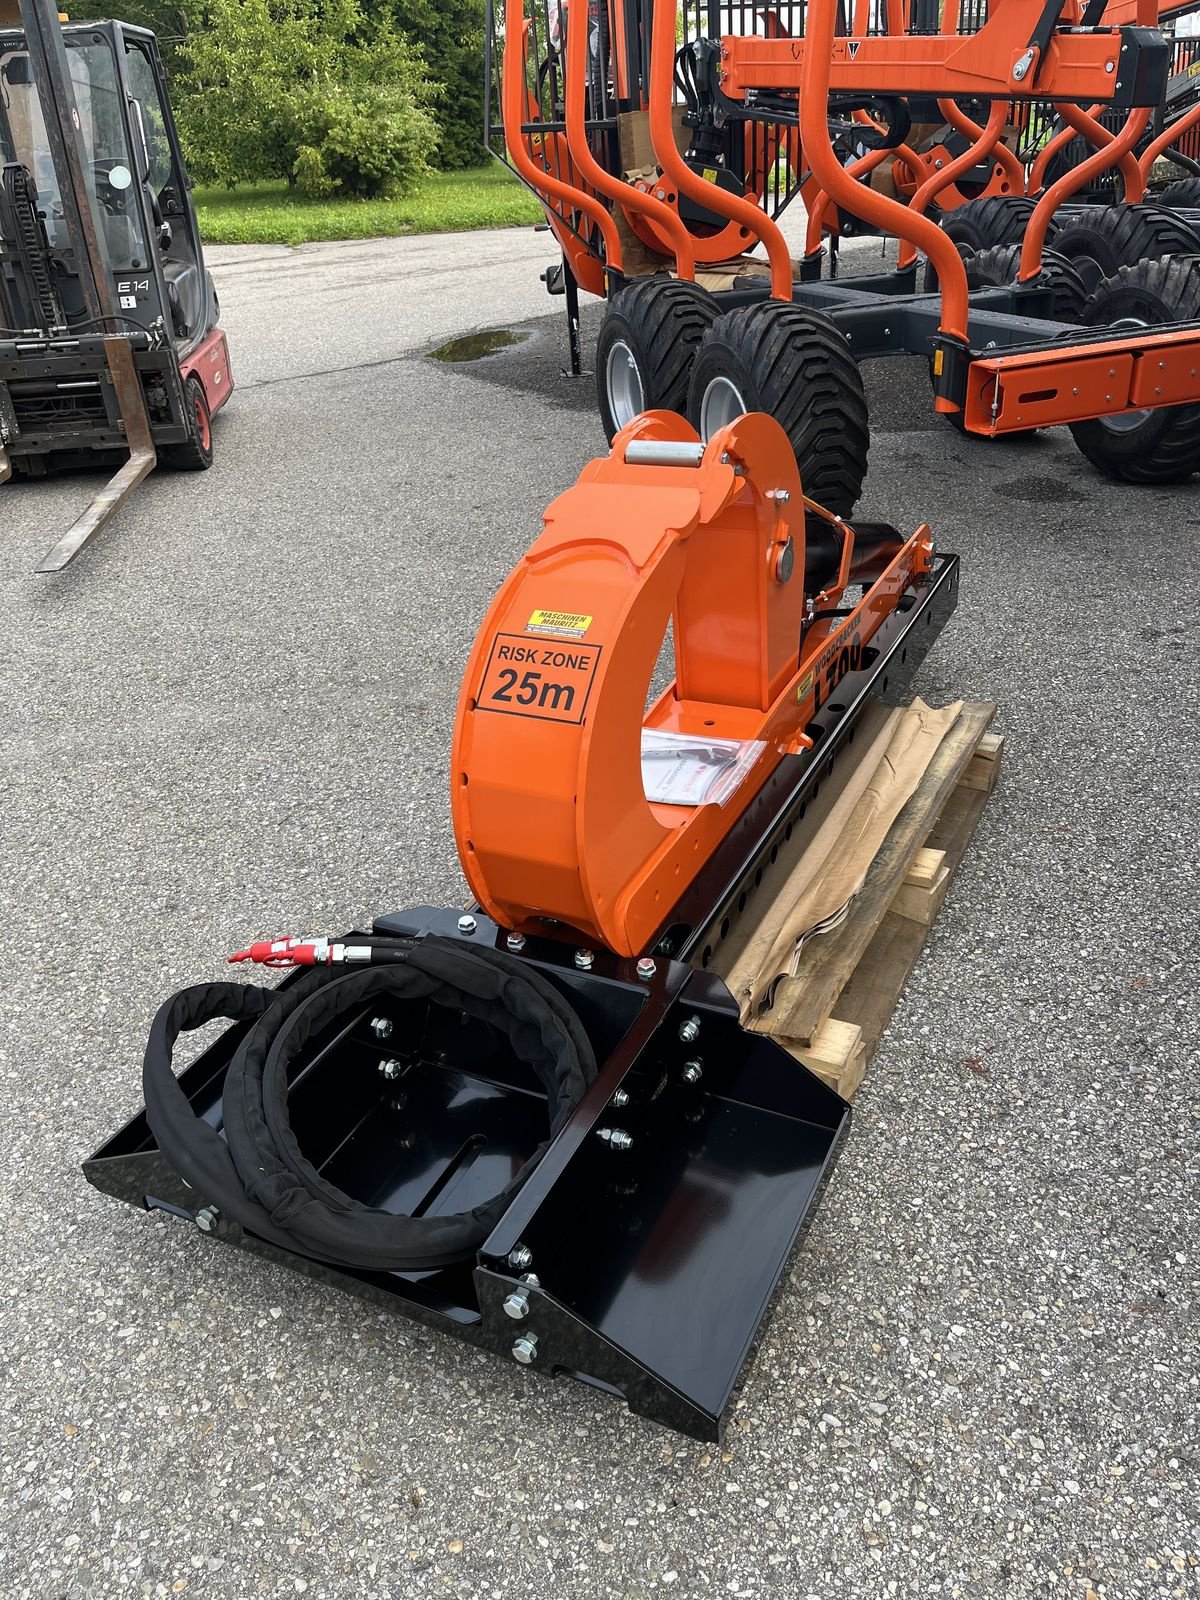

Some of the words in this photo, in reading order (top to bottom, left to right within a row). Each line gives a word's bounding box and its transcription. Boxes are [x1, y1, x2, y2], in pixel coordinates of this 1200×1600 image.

[539, 611, 588, 623] MASCHINEN
[541, 618, 578, 628] MAURITZ
[498, 645, 539, 664] RISK
[541, 651, 591, 671] ZONE
[491, 668, 575, 711] 25m
